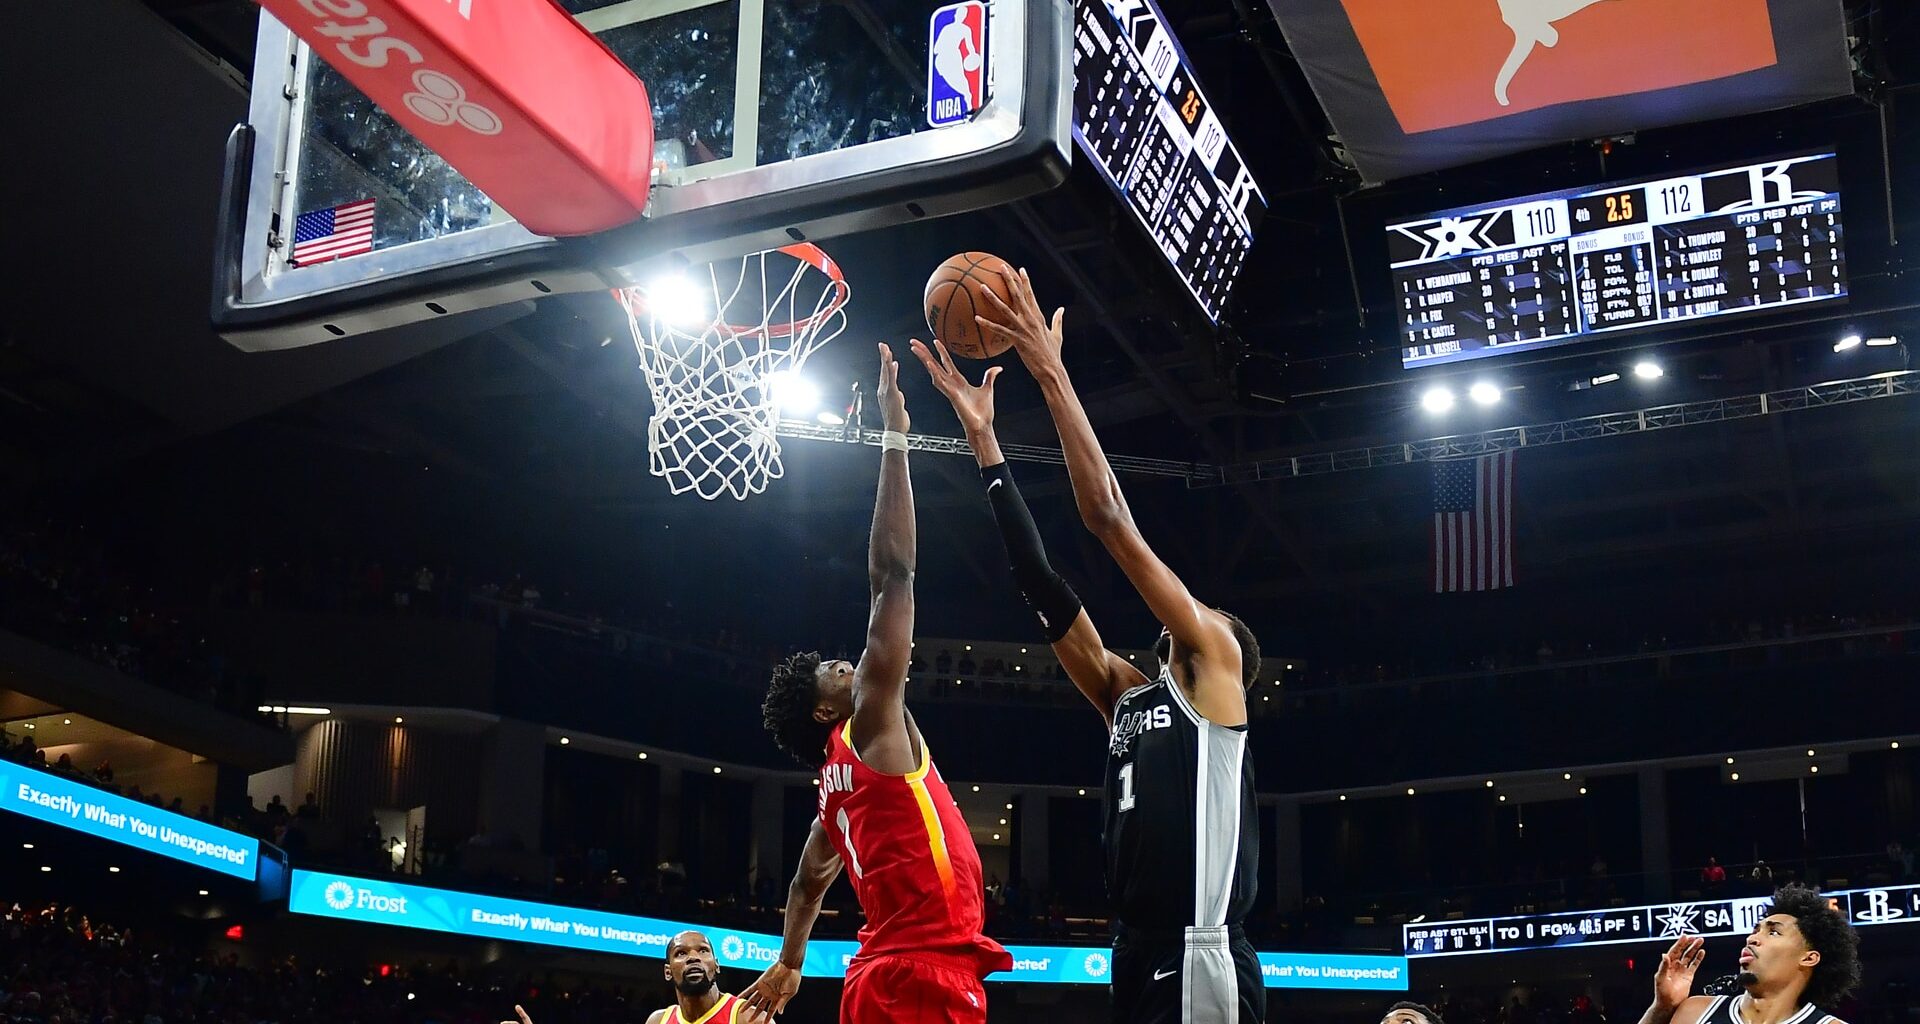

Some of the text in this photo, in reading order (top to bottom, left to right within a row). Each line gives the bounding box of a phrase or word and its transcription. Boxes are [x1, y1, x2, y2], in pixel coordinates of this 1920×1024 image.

[1151, 40, 1171, 79] 110
[1181, 90, 1200, 124] 2.5
[1202, 123, 1220, 160] 112
[936, 97, 961, 120] NBA
[1528, 207, 1556, 237] 110
[1576, 208, 1590, 222] 4th
[1606, 195, 1633, 222] 2.5
[1661, 185, 1691, 215] 112
[1737, 200, 1836, 224] PTS REB AST PF
[1624, 231, 1645, 242] BONUS
[1577, 239, 1598, 251] BONUS
[1472, 244, 1565, 267] PTS REB AST PF
[1604, 253, 1623, 263] FLS
[1605, 265, 1624, 275] TOL
[1604, 277, 1627, 287] FG%
[1603, 287, 1631, 299] 3PT%
[1607, 299, 1629, 310] FT%
[1603, 309, 1636, 321] TURNS
[1431, 324, 1455, 338] CASTLE
[1119, 762, 1135, 813] 1
[18, 784, 82, 818] Exactly
[84, 802, 127, 829] What
[129, 817, 158, 839] You
[357, 888, 408, 914] Frost
[472, 909, 528, 931] Exactly
[531, 917, 569, 934] What
[573, 925, 599, 938] You
[747, 942, 781, 961] Fros
[1705, 909, 1731, 927] SA
[1410, 927, 1488, 940] REB AST STL BLK
[1498, 916, 1640, 940] TO 0 FG% 48.5 PF 5
[1414, 935, 1481, 951] 47 21 10 3
[1261, 964, 1293, 977] What
[1296, 966, 1319, 977] You
